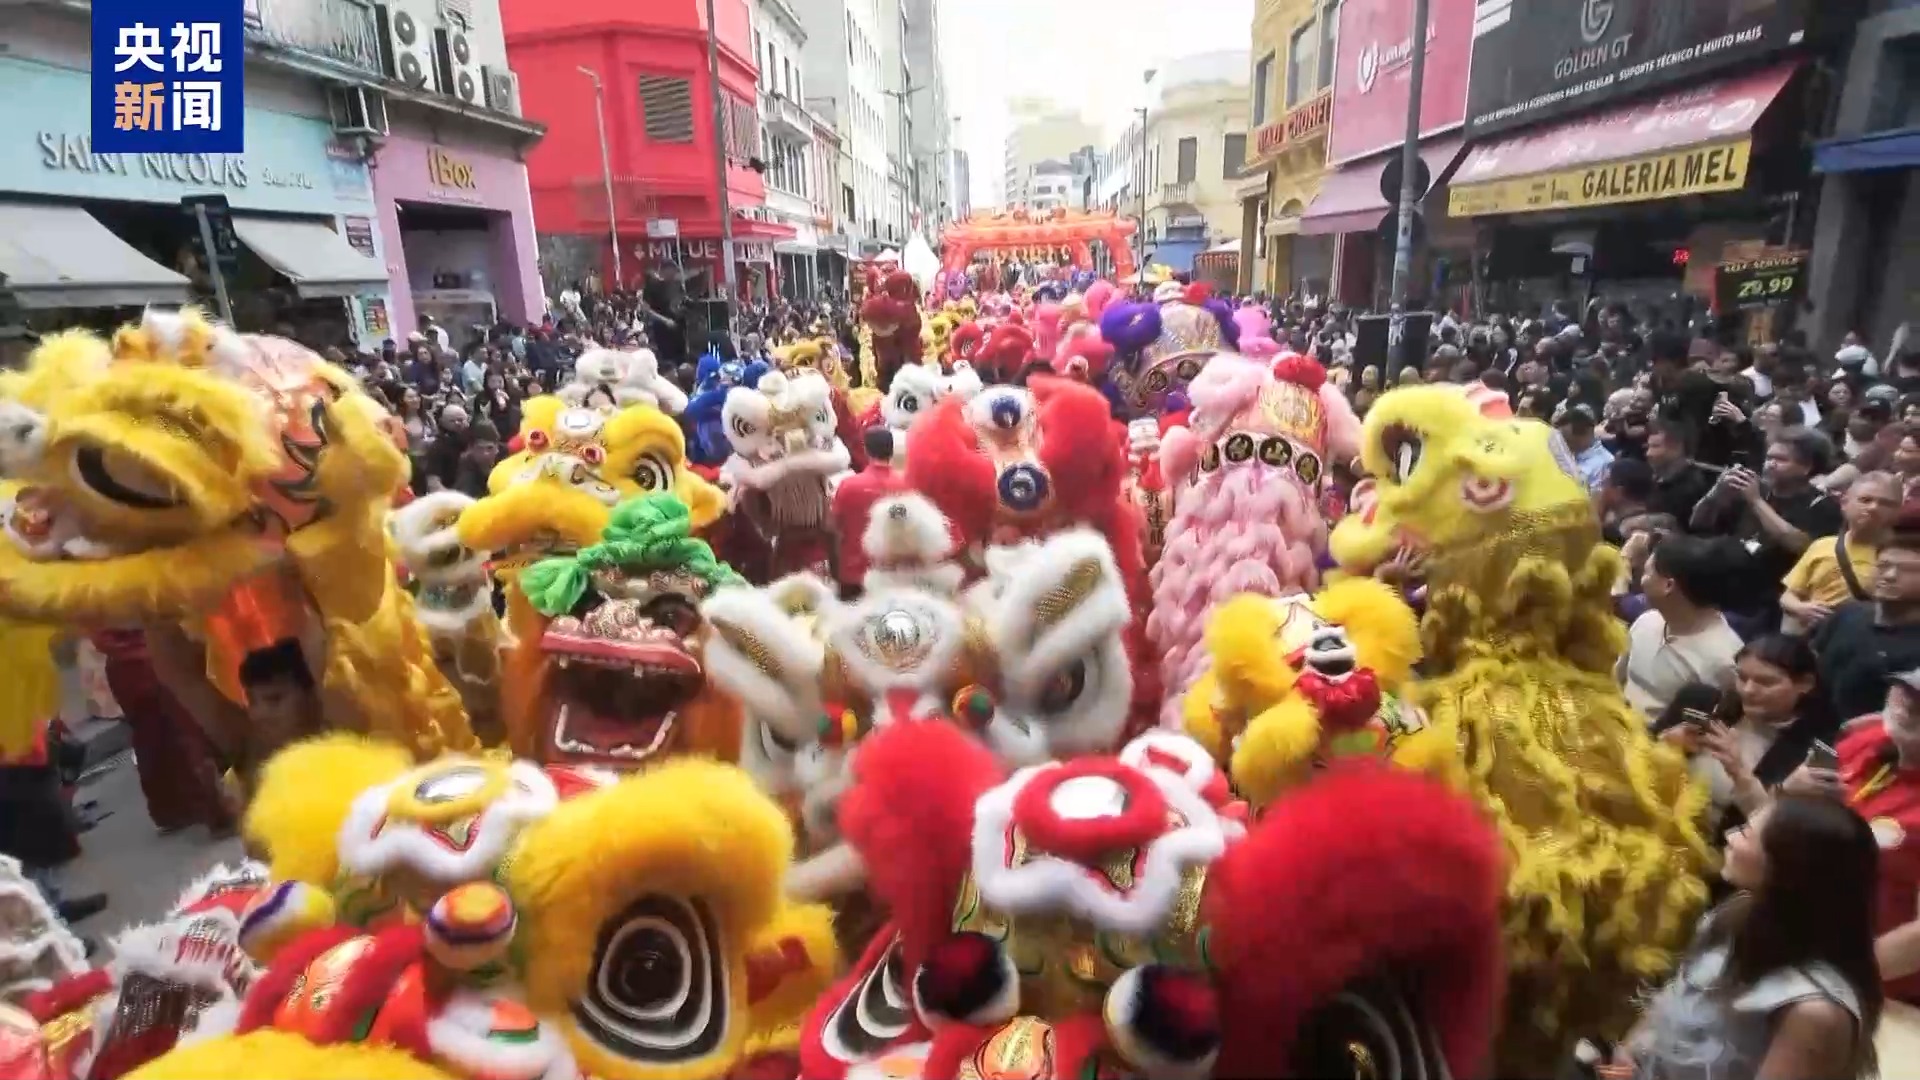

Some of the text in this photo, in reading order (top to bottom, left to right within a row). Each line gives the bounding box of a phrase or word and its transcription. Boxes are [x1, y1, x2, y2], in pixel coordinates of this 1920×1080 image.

[1554, 33, 1633, 80] GOLDEN GT
[1565, 84, 1583, 98] PARA
[1584, 74, 1614, 91] CELULAR
[1619, 60, 1655, 81] SUPORTE
[1656, 47, 1693, 68] TÉCNICO
[1694, 44, 1701, 58] E
[1702, 33, 1734, 54] MUITO
[1735, 24, 1763, 44] MAIS
[140, 152, 248, 188] NICOLAS
[1582, 159, 1676, 199] GALERIA
[1682, 147, 1737, 187] MEL
[648, 240, 718, 259] MIUE
